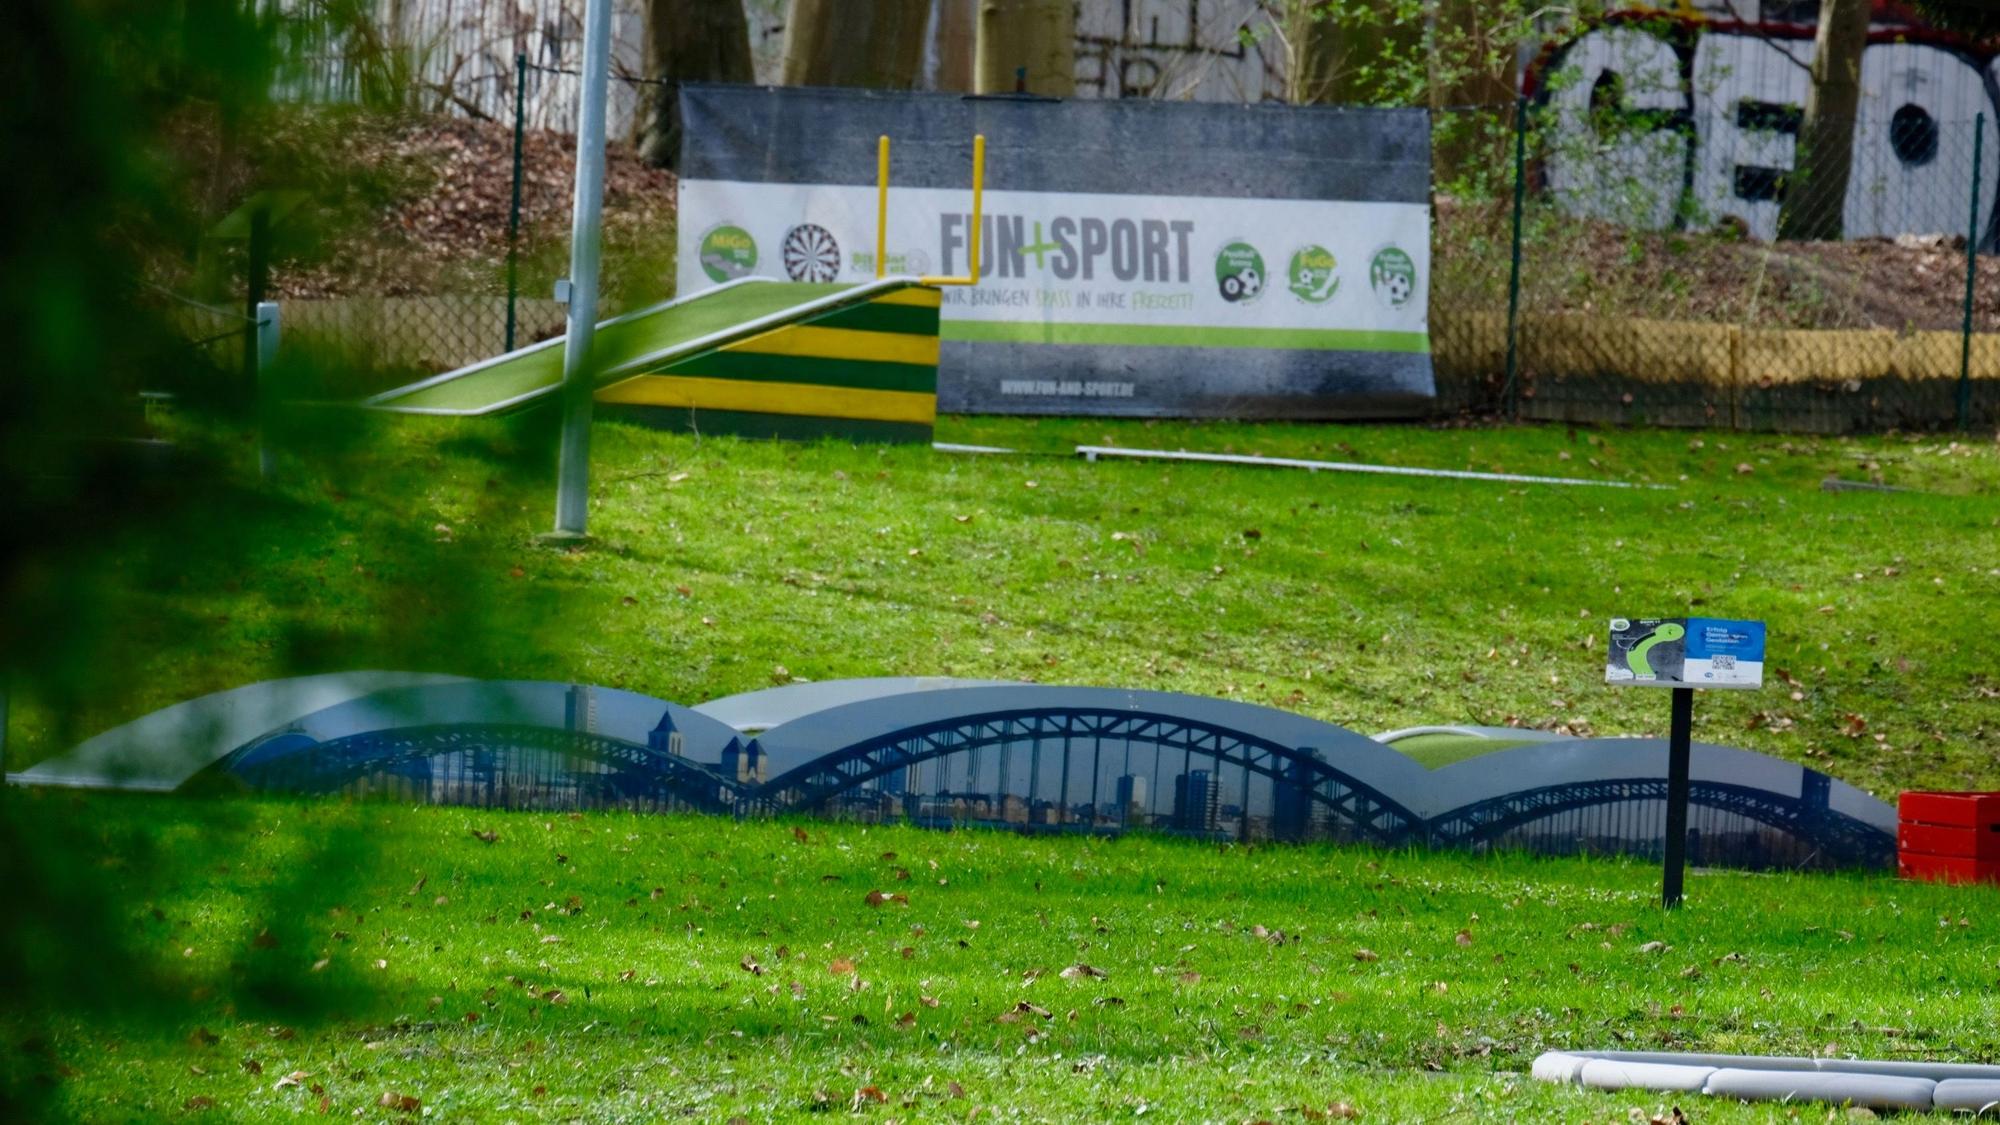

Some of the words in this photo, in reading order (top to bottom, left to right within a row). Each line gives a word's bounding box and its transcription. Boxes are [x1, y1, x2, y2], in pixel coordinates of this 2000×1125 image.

[971, 287, 1031, 308] BRINGEN
[1076, 289, 1092, 308] IN
[1097, 291, 1126, 309] IHRE
